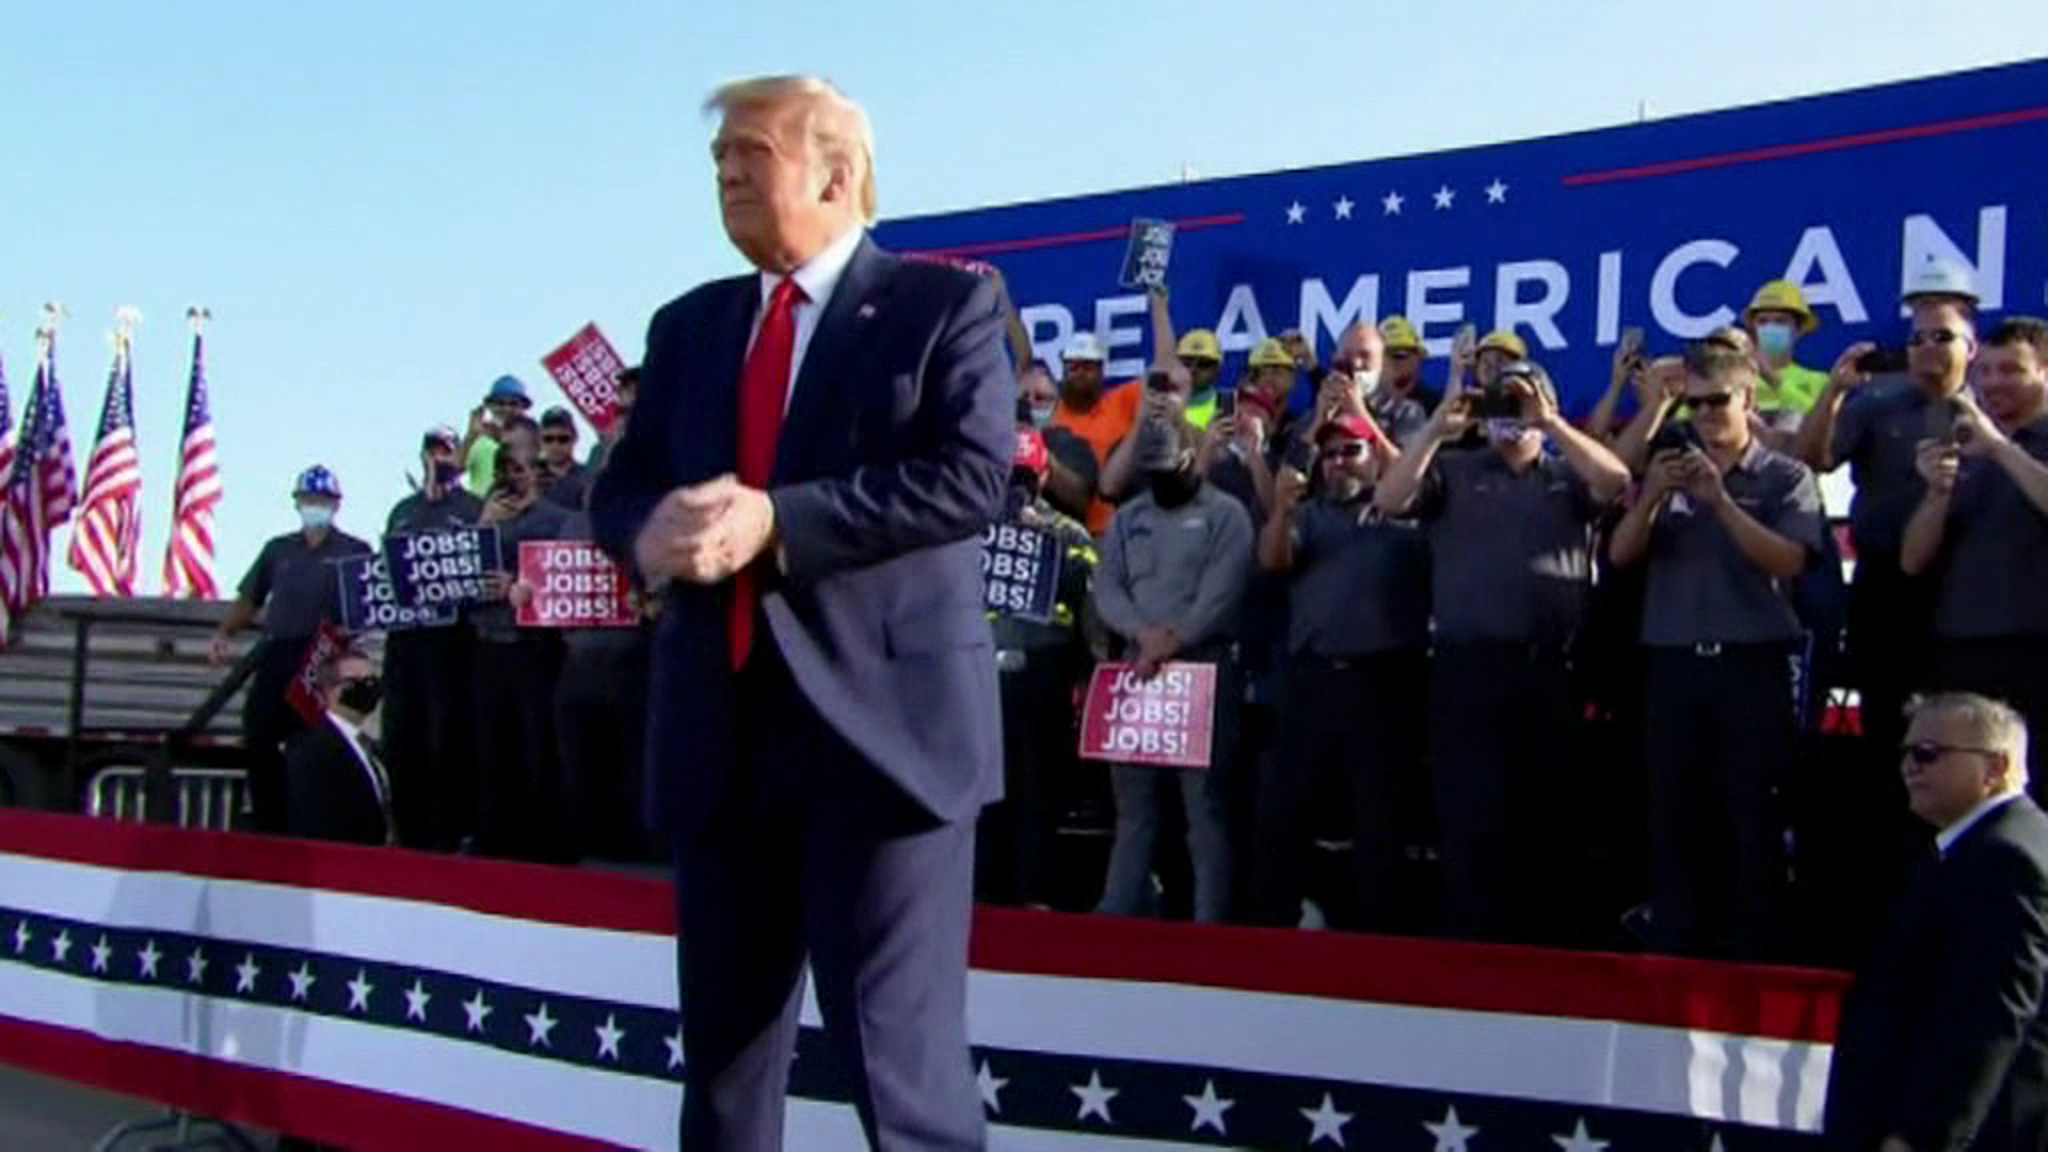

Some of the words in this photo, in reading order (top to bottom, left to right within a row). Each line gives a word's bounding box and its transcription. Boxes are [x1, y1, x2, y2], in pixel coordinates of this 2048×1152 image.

[1020, 294, 1147, 381] RE
[1215, 206, 2006, 358] AMERICAN
[403, 531, 480, 559] JOBS!
[541, 548, 615, 569] JOBS
[408, 553, 481, 581] JOBS!
[541, 573, 617, 593] JOBS!
[987, 579, 1034, 609] BS!
[540, 597, 617, 618] JOBS!
[1109, 671, 1192, 698] JOBS!
[1104, 696, 1190, 727] JOBS!
[1101, 725, 1188, 756] JOBS!
